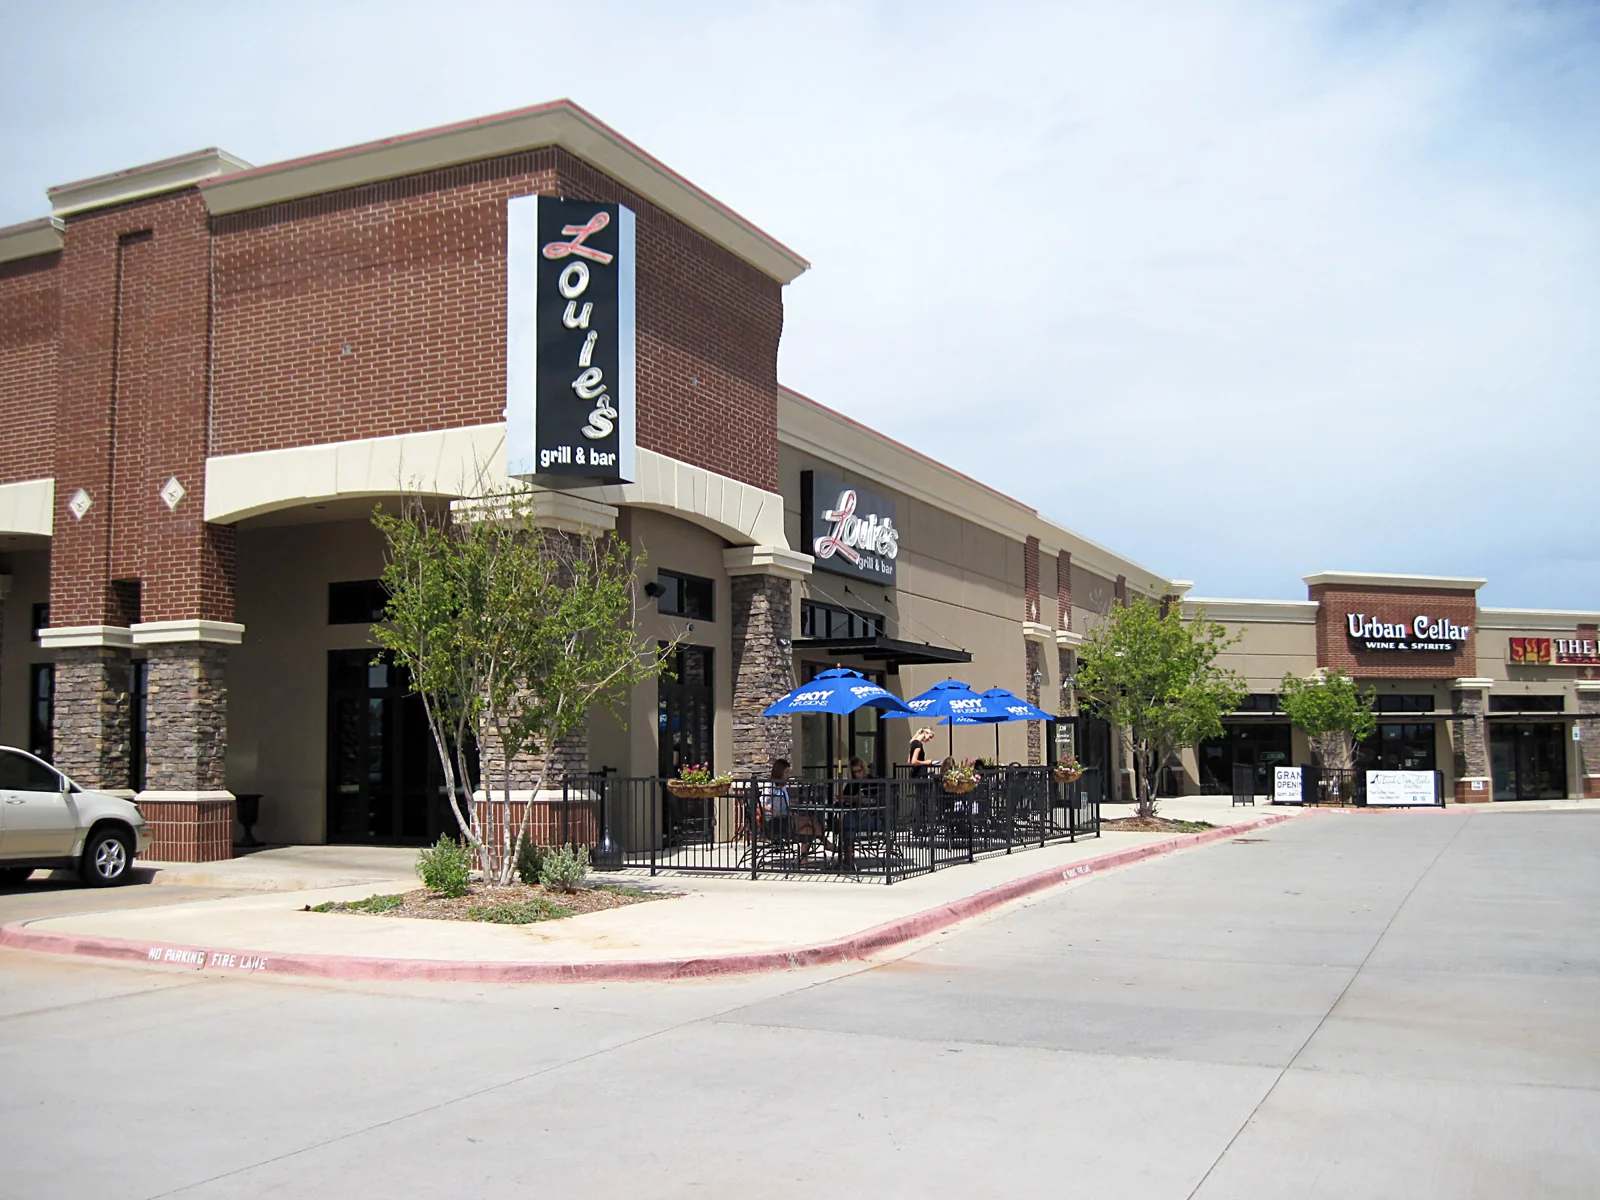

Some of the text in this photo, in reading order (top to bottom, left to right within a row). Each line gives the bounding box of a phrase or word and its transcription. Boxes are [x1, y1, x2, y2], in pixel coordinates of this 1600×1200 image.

[542, 211, 618, 439] Louie's
[540, 446, 616, 468] grill & bar
[814, 489, 899, 560] Louie's
[858, 556, 893, 574] grill & bar
[1346, 613, 1470, 640] Urban Cellar
[1365, 641, 1452, 650] WINE & SPIRITS
[1555, 639, 1592, 654] THE
[792, 690, 835, 702] SKYY
[949, 698, 983, 709] SKYY
[1276, 771, 1302, 780] GRAN
[1276, 781, 1302, 789] OPENIN
[148, 948, 268, 970] NO PARKING FIRE LANE
